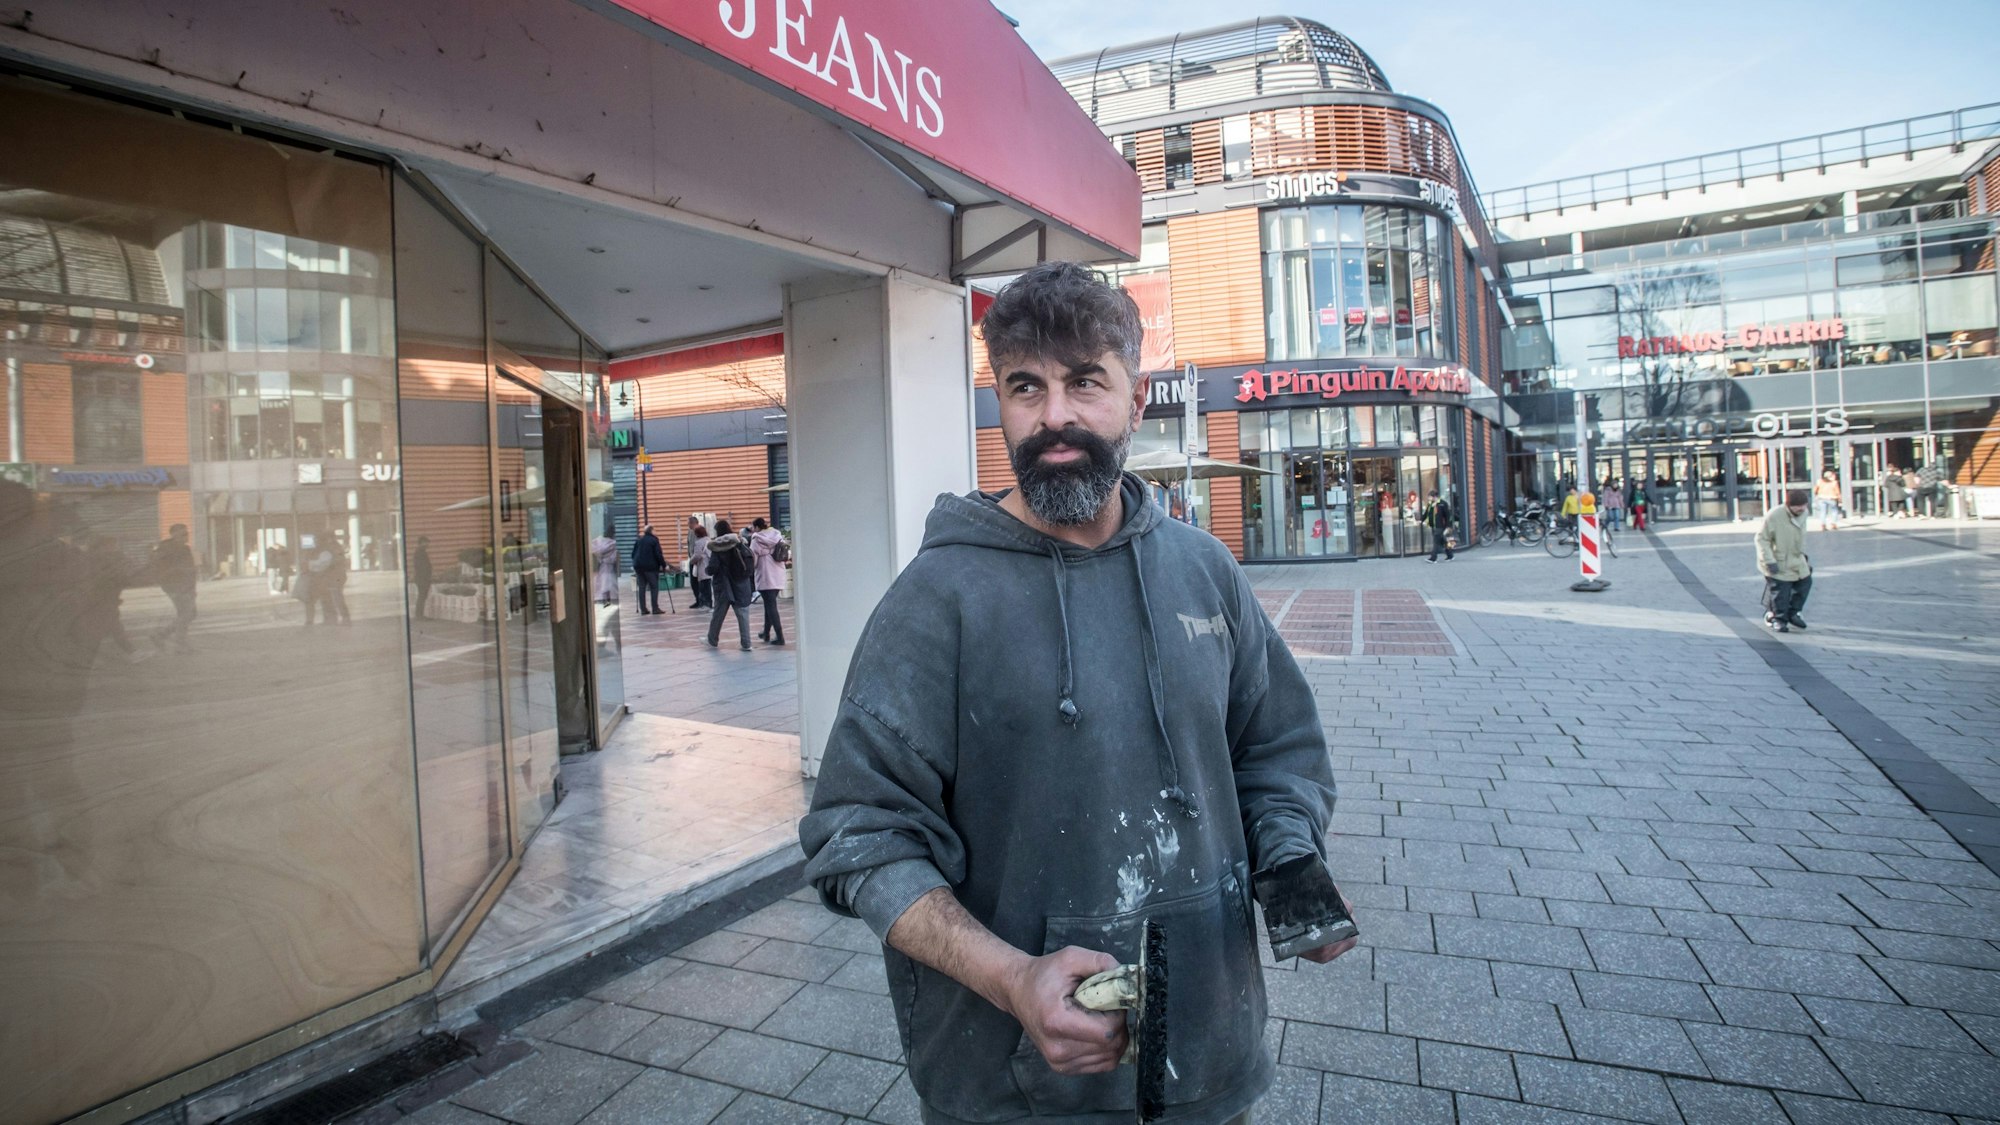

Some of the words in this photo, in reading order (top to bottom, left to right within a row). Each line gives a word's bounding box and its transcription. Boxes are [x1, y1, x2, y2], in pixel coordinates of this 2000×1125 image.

[718, 0, 944, 137] JEANS
[1265, 171, 1339, 202] snipes
[1270, 365, 1387, 399] Pinguin
[1623, 408, 1850, 444] KINOPOLIS
